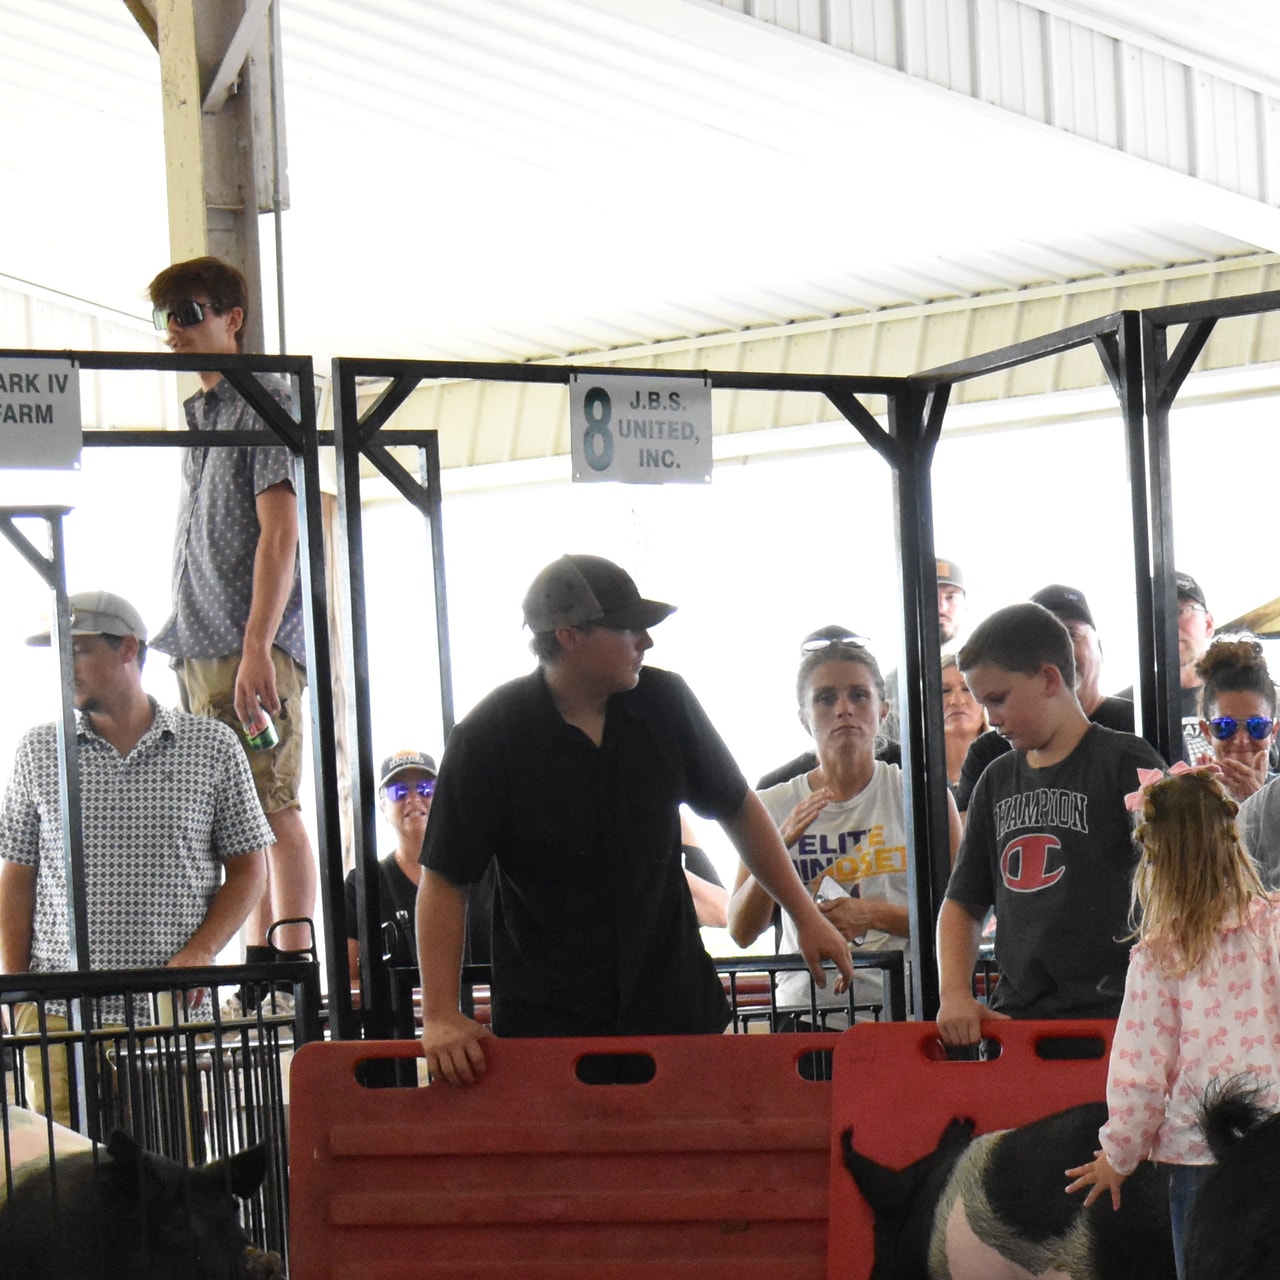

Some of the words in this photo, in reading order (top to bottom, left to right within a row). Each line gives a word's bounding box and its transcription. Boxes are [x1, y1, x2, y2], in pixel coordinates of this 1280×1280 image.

[48, 373, 69, 394] IV
[630, 390, 687, 412] J.B.S.
[0, 403, 54, 424] ARM
[583, 386, 614, 472] 8
[618, 418, 700, 445] UNITED,
[639, 448, 682, 469] INC.
[798, 824, 886, 856] ELITE
